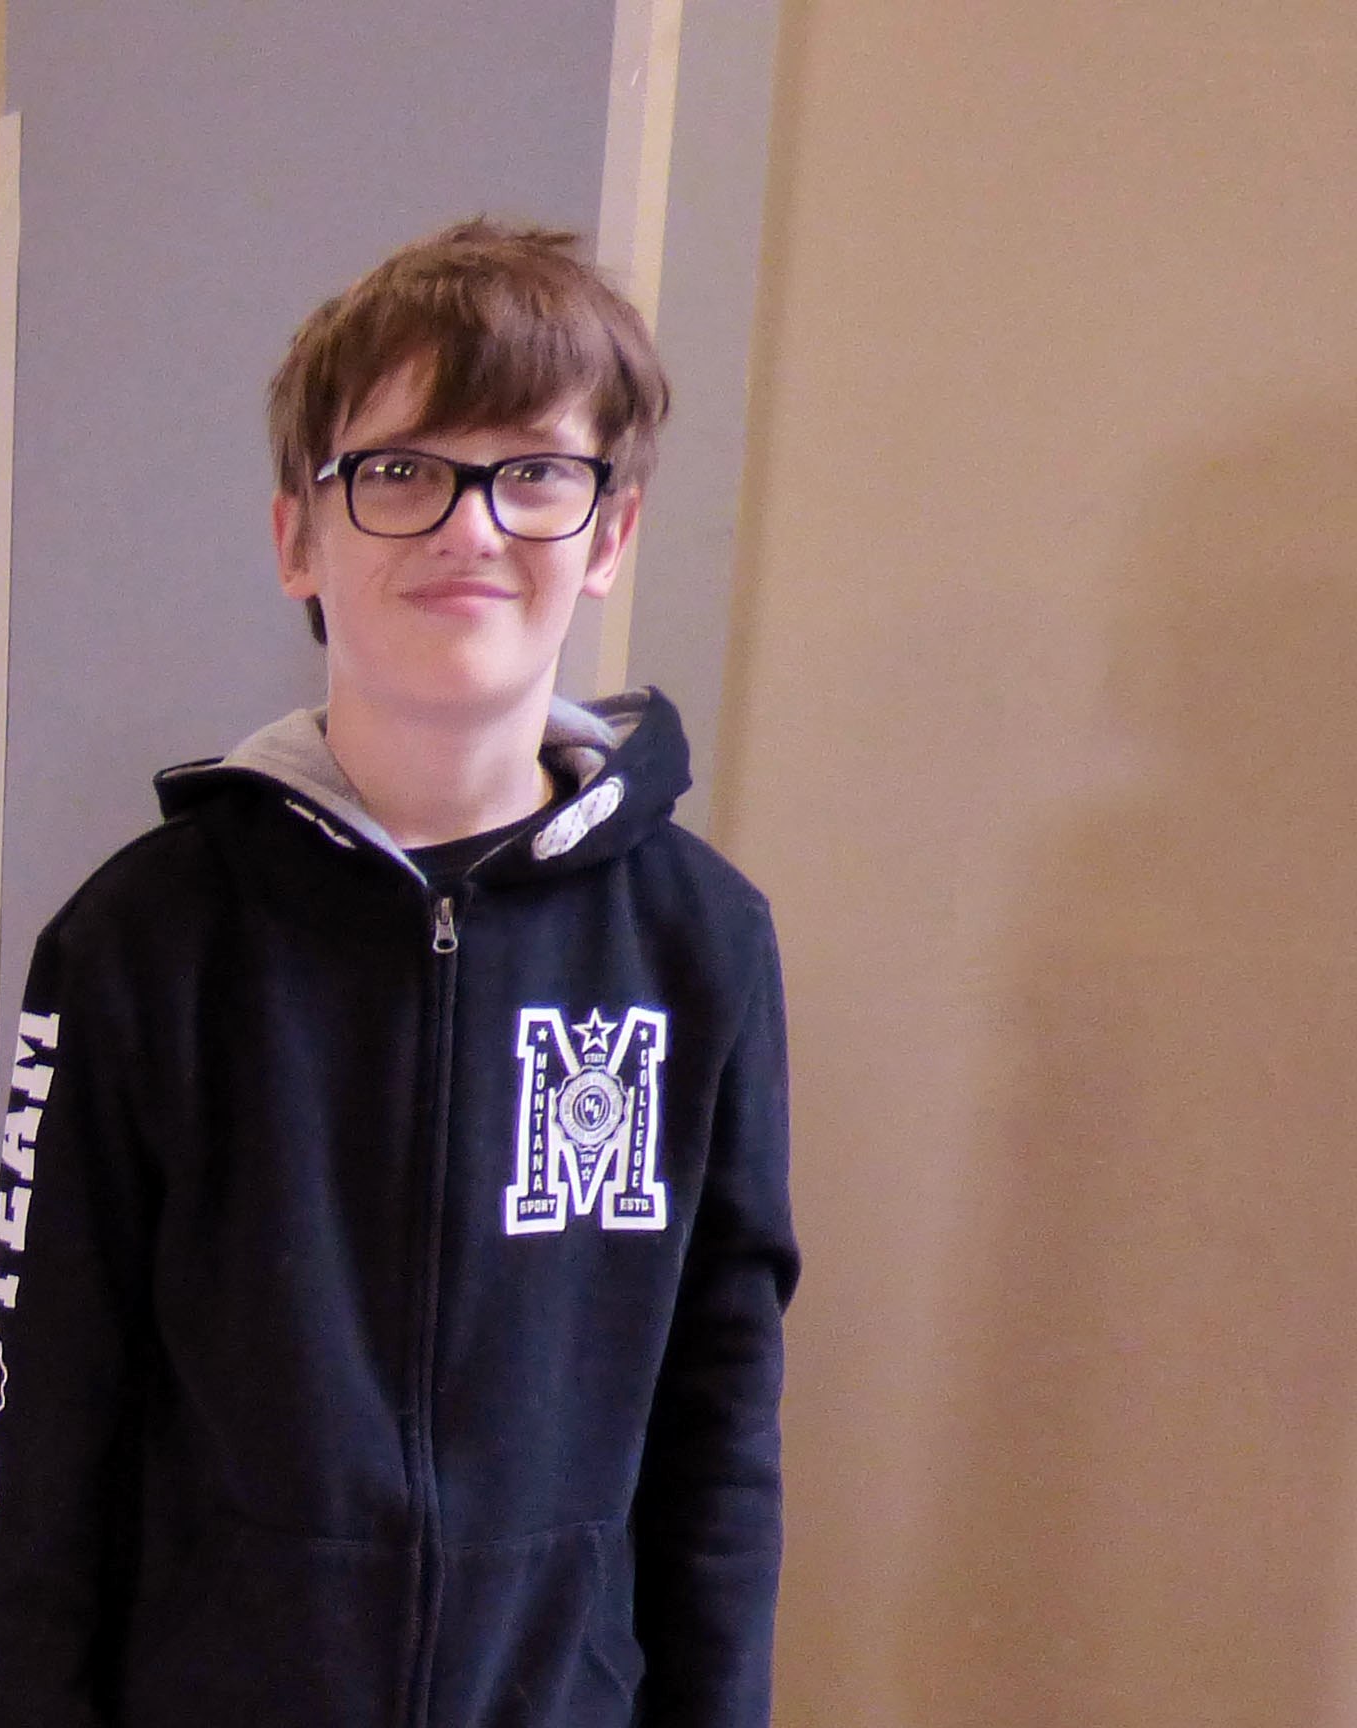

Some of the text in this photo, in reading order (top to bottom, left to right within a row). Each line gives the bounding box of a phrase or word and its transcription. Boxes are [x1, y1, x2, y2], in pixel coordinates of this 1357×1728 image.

[533, 1052, 548, 1192] MONTANA
[631, 1050, 649, 1189] COLLEGE
[519, 1199, 557, 1215] SPORT
